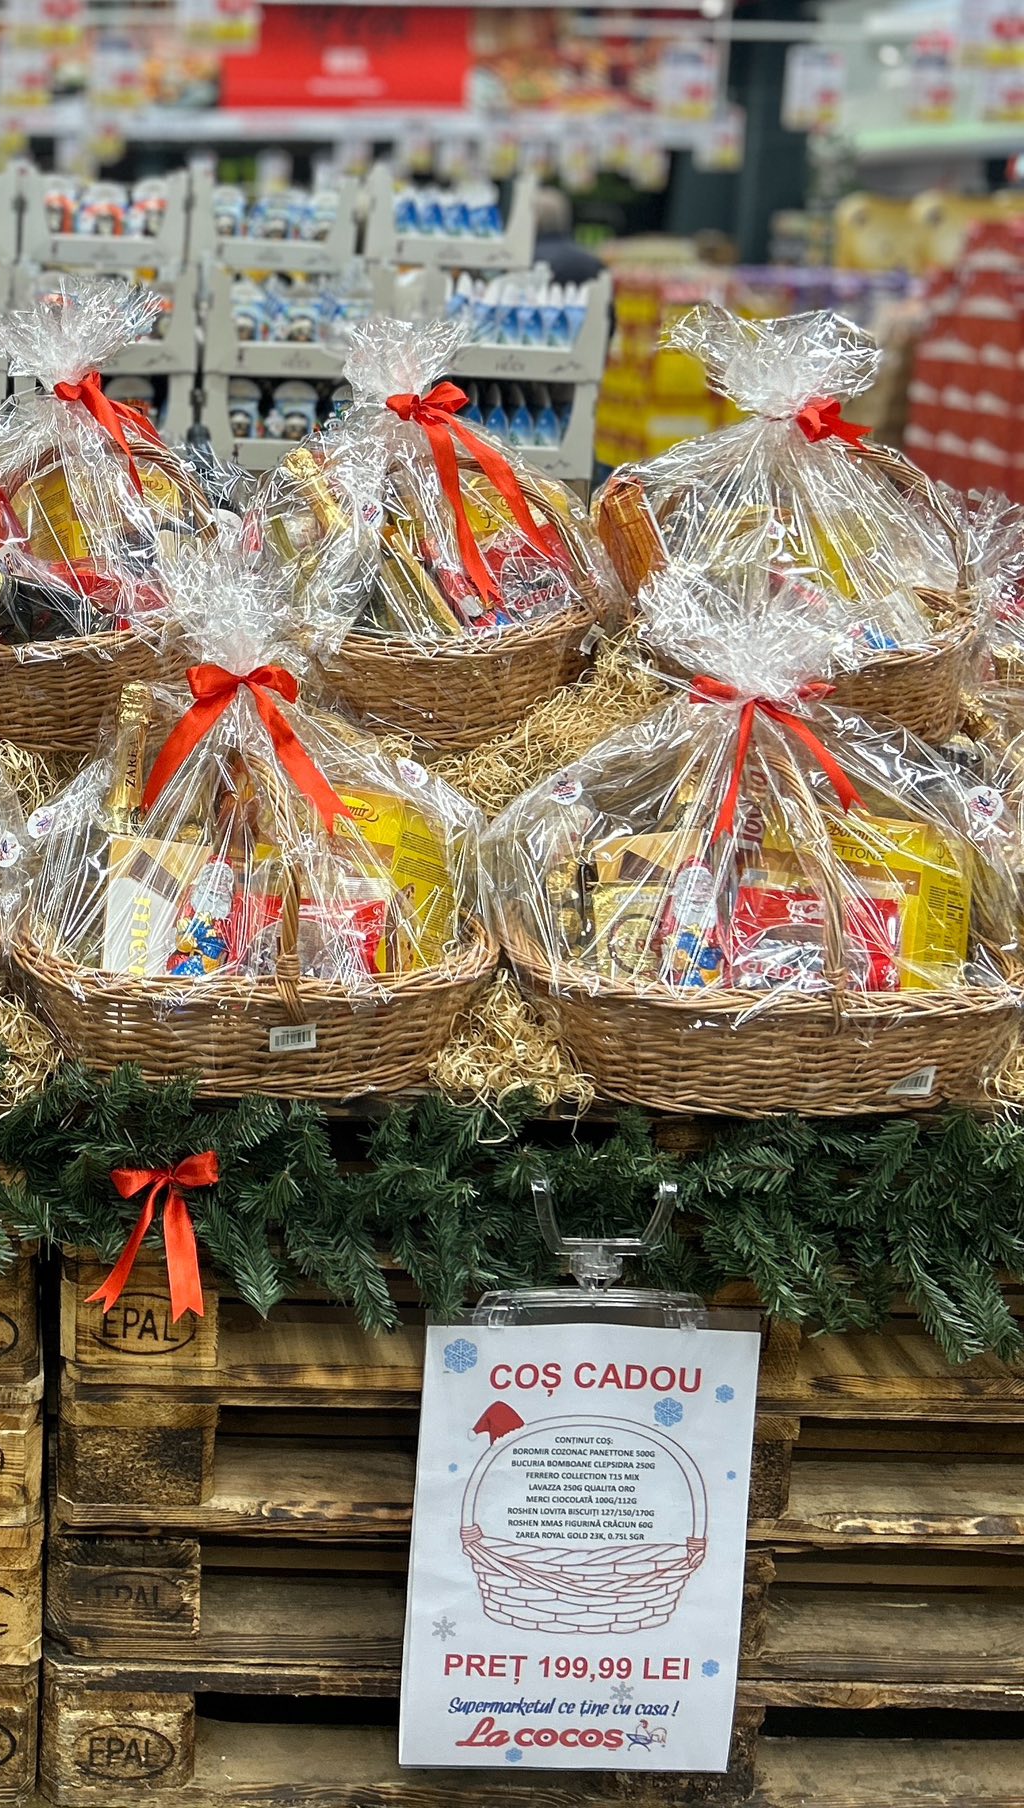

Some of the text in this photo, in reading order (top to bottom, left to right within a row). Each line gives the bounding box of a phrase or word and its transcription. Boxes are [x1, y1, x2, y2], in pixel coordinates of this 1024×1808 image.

[129, 897, 151, 976] mer
[102, 1306, 180, 1343] EPAL
[490, 1362, 702, 1397] COȘ CADOU
[551, 1448, 588, 1456] COZONAC
[589, 1449, 634, 1457] PANETTONE
[636, 1450, 655, 1458] 500G
[547, 1460, 592, 1468] BOMBOANE
[593, 1461, 634, 1469] CLEPSIDRA
[561, 1472, 607, 1480] COLLECTION
[608, 1473, 623, 1481] T15
[624, 1473, 640, 1481] MIX
[584, 1484, 616, 1493] QUALITA
[618, 1485, 636, 1493] ORO
[507, 1507, 538, 1515] ROSHEN
[508, 1519, 539, 1527] ROSHEN
[638, 1521, 653, 1529] 60G
[516, 1531, 540, 1539] ZAREA
[567, 1532, 588, 1540] GOLD
[443, 1654, 690, 1684] PREȚ 199,99 LEI
[448, 1697, 556, 1716] Supermarketul
[558, 1702, 576, 1715] ce
[612, 1703, 630, 1716] cu
[635, 1703, 670, 1716] casa
[455, 1717, 511, 1748] La
[88, 1736, 165, 1768] EPAL
